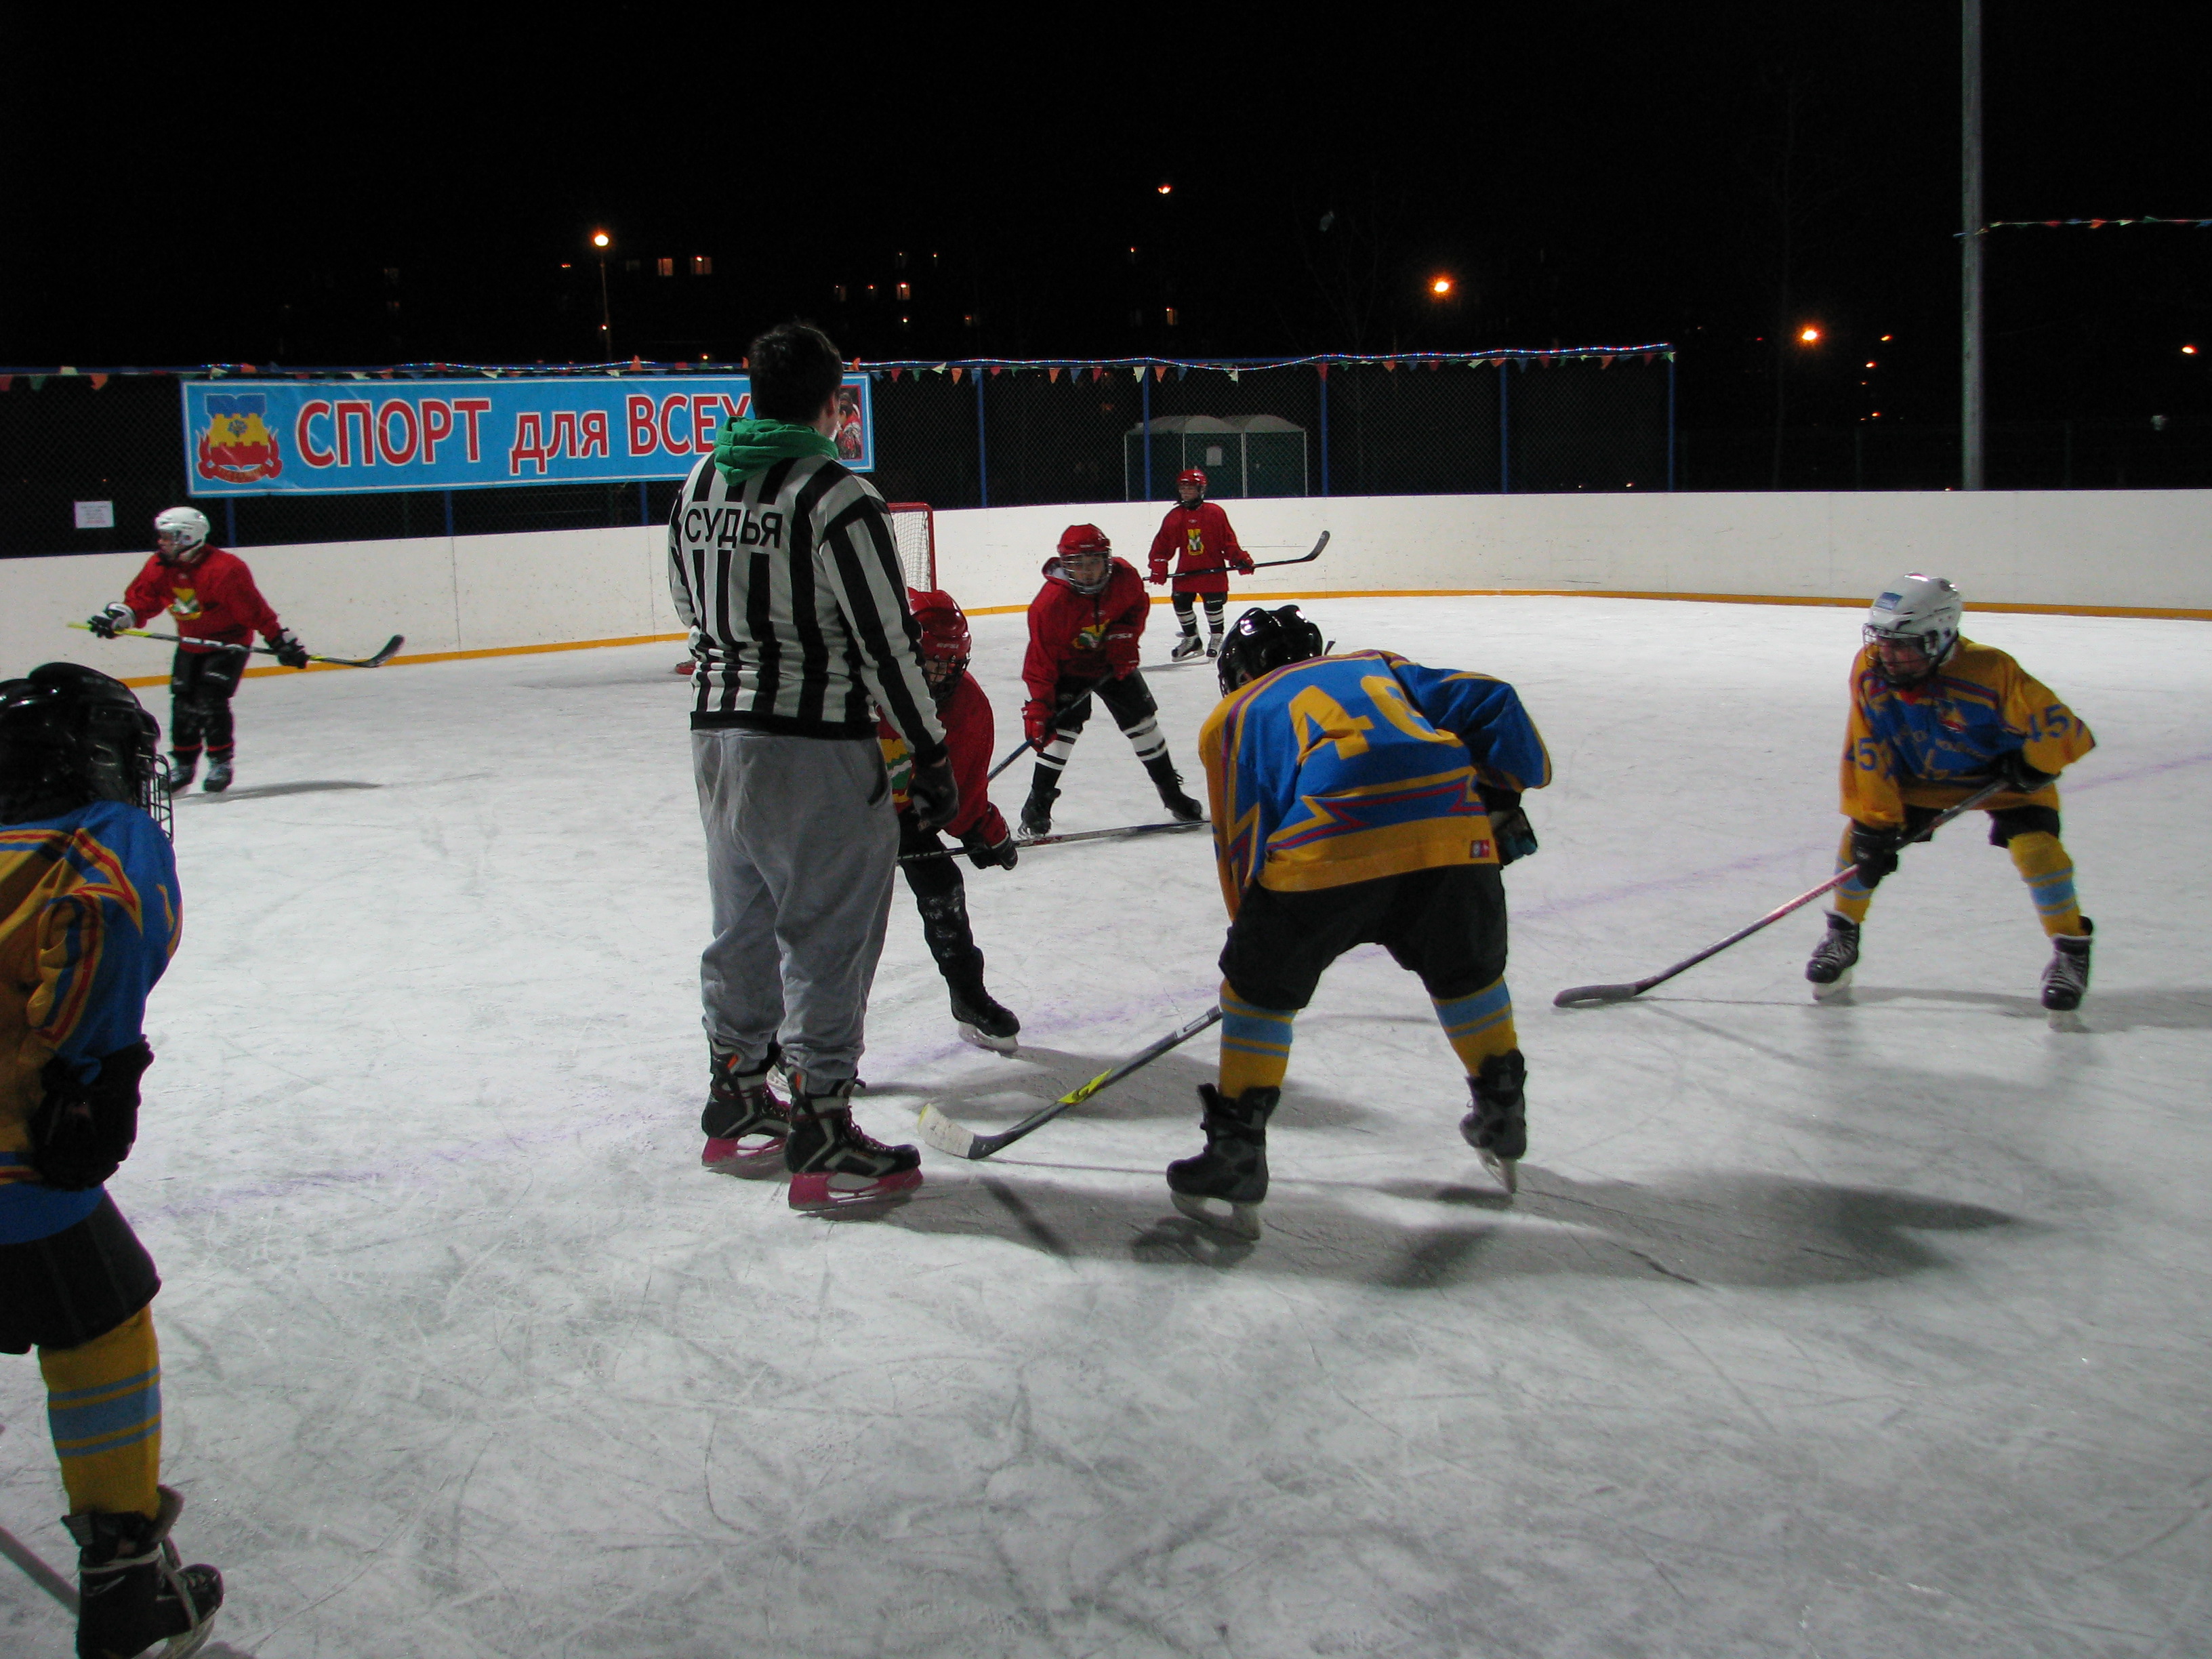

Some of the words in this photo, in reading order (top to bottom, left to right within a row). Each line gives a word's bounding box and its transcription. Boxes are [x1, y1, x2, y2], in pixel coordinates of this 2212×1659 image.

[298, 398, 490, 467] СПОРТ
[510, 411, 609, 474] для
[684, 508, 783, 549] СУДЬЯ
